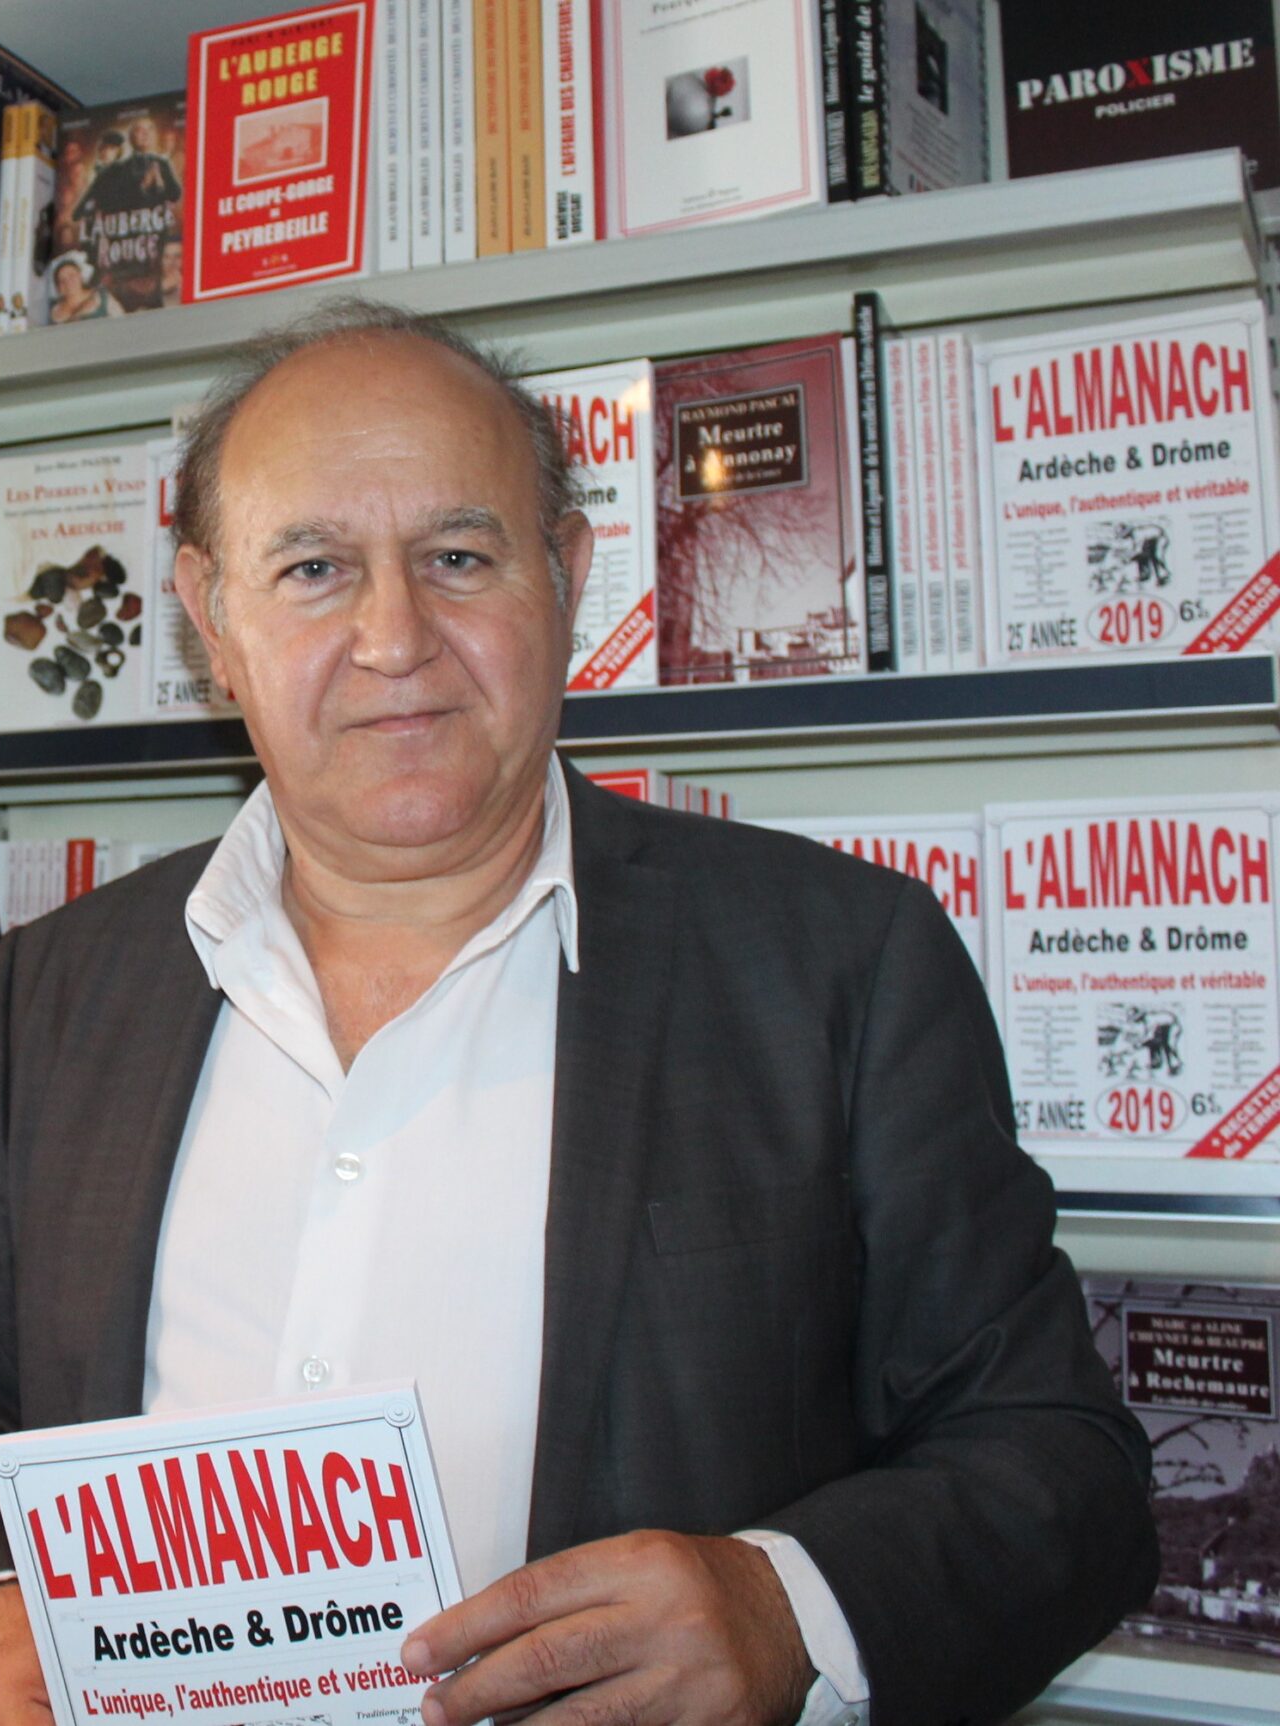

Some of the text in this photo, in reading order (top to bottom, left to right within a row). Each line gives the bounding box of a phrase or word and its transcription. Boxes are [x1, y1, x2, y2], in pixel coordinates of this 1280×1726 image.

[219, 32, 344, 80] L'AUBERGE
[1017, 37, 1256, 110] PAROXISME
[241, 68, 318, 106] ROUGE
[559, 86, 575, 111] DES
[1094, 93, 1176, 119] POLICIER
[560, 115, 577, 176] L'AFFAIRE
[235, 174, 334, 213] COUPE-GORGE
[221, 211, 329, 254] PEYREBEILLE
[992, 340, 1250, 443] L'ALMANACH
[698, 421, 784, 447] Meurtre
[684, 454, 696, 473] à
[1019, 440, 1231, 482] Ardèche & Drôme
[1004, 479, 1249, 520] L'unique, l'authentique et véritable
[1098, 600, 1163, 645] 2019
[1004, 818, 1270, 910] L'ALMANACH
[1029, 925, 1248, 954] Ardèche & Drôme
[1013, 970, 1267, 995] L'unique, l'authentique et véritable
[1108, 1088, 1175, 1133] 2019
[1153, 1347, 1244, 1373] Meurtre
[1145, 1371, 1270, 1398] Rochemaure
[27, 1448, 423, 1600] L'ALMANACH
[93, 1599, 404, 1662] Ardèche & Drôme
[82, 1688, 174, 1719] L'unique,
[174, 1675, 312, 1707] l'authentique
[317, 1668, 341, 1696] et
[355, 1708, 400, 1720] Traditions
